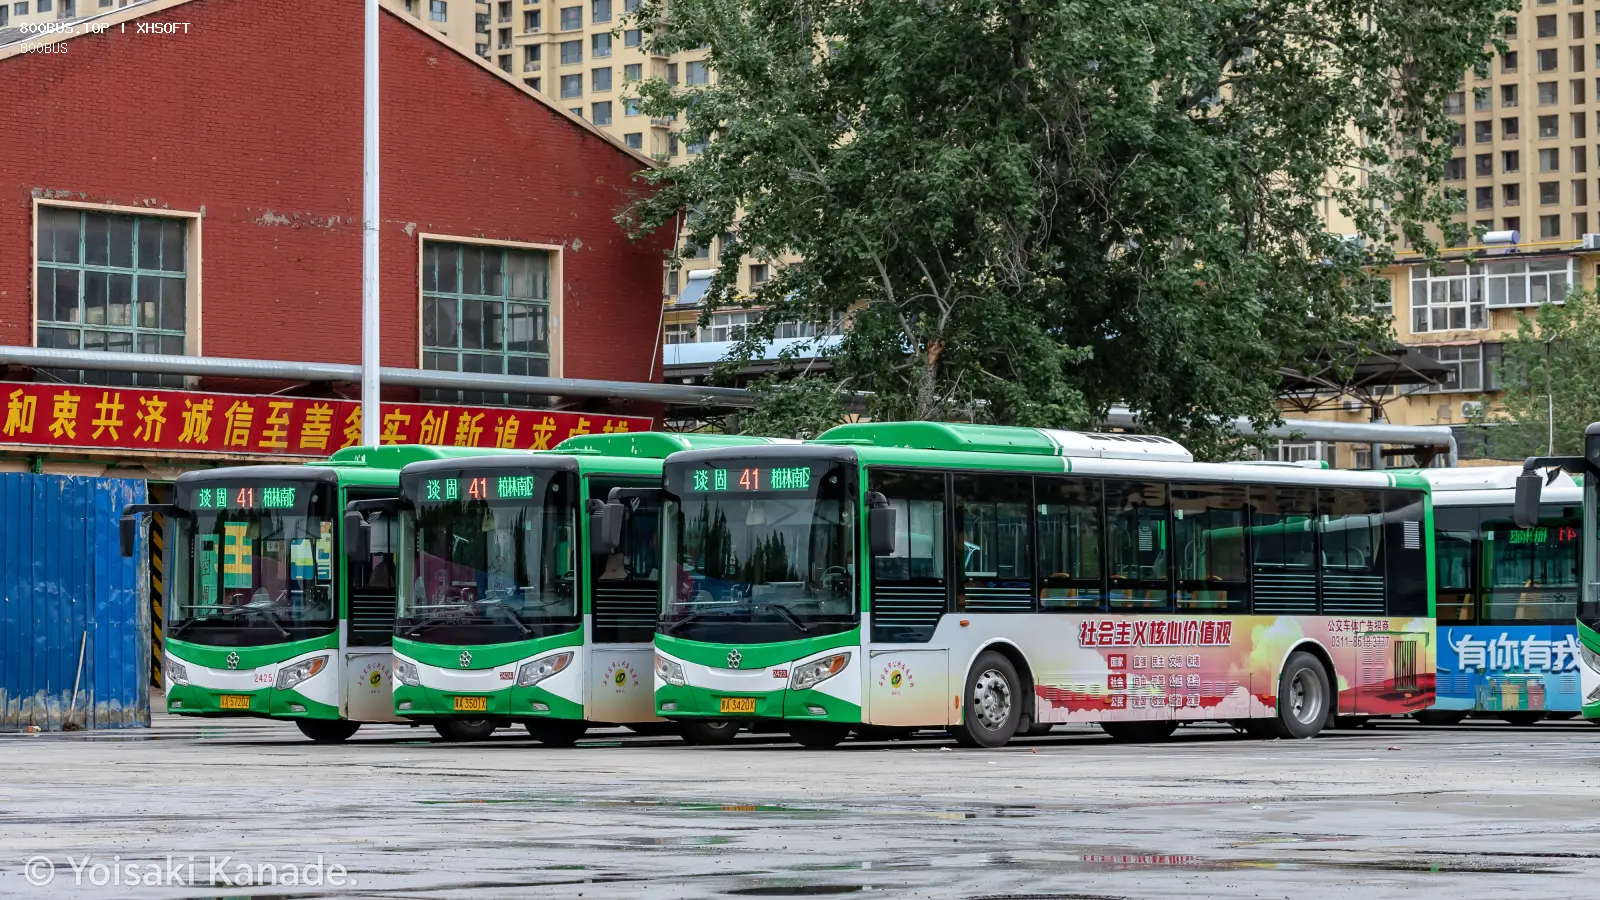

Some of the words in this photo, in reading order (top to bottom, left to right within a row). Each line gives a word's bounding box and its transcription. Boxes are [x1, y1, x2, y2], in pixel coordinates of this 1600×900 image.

[468, 477, 486, 499] 41
[739, 468, 759, 490] 41
[236, 487, 253, 508] 41
[1079, 620, 1233, 647] 社会主义核心价值观
[1327, 619, 1390, 632] 公交车体广告招商
[1110, 656, 1124, 668] 国家
[1133, 655, 1147, 668] 富强
[1151, 655, 1165, 668] 民主
[1169, 655, 1182, 668] 文明
[1456, 632, 1581, 673] 有你有我
[254, 673, 273, 683] 2425
[1110, 676, 1124, 688] 社会
[1133, 675, 1147, 688] 自由
